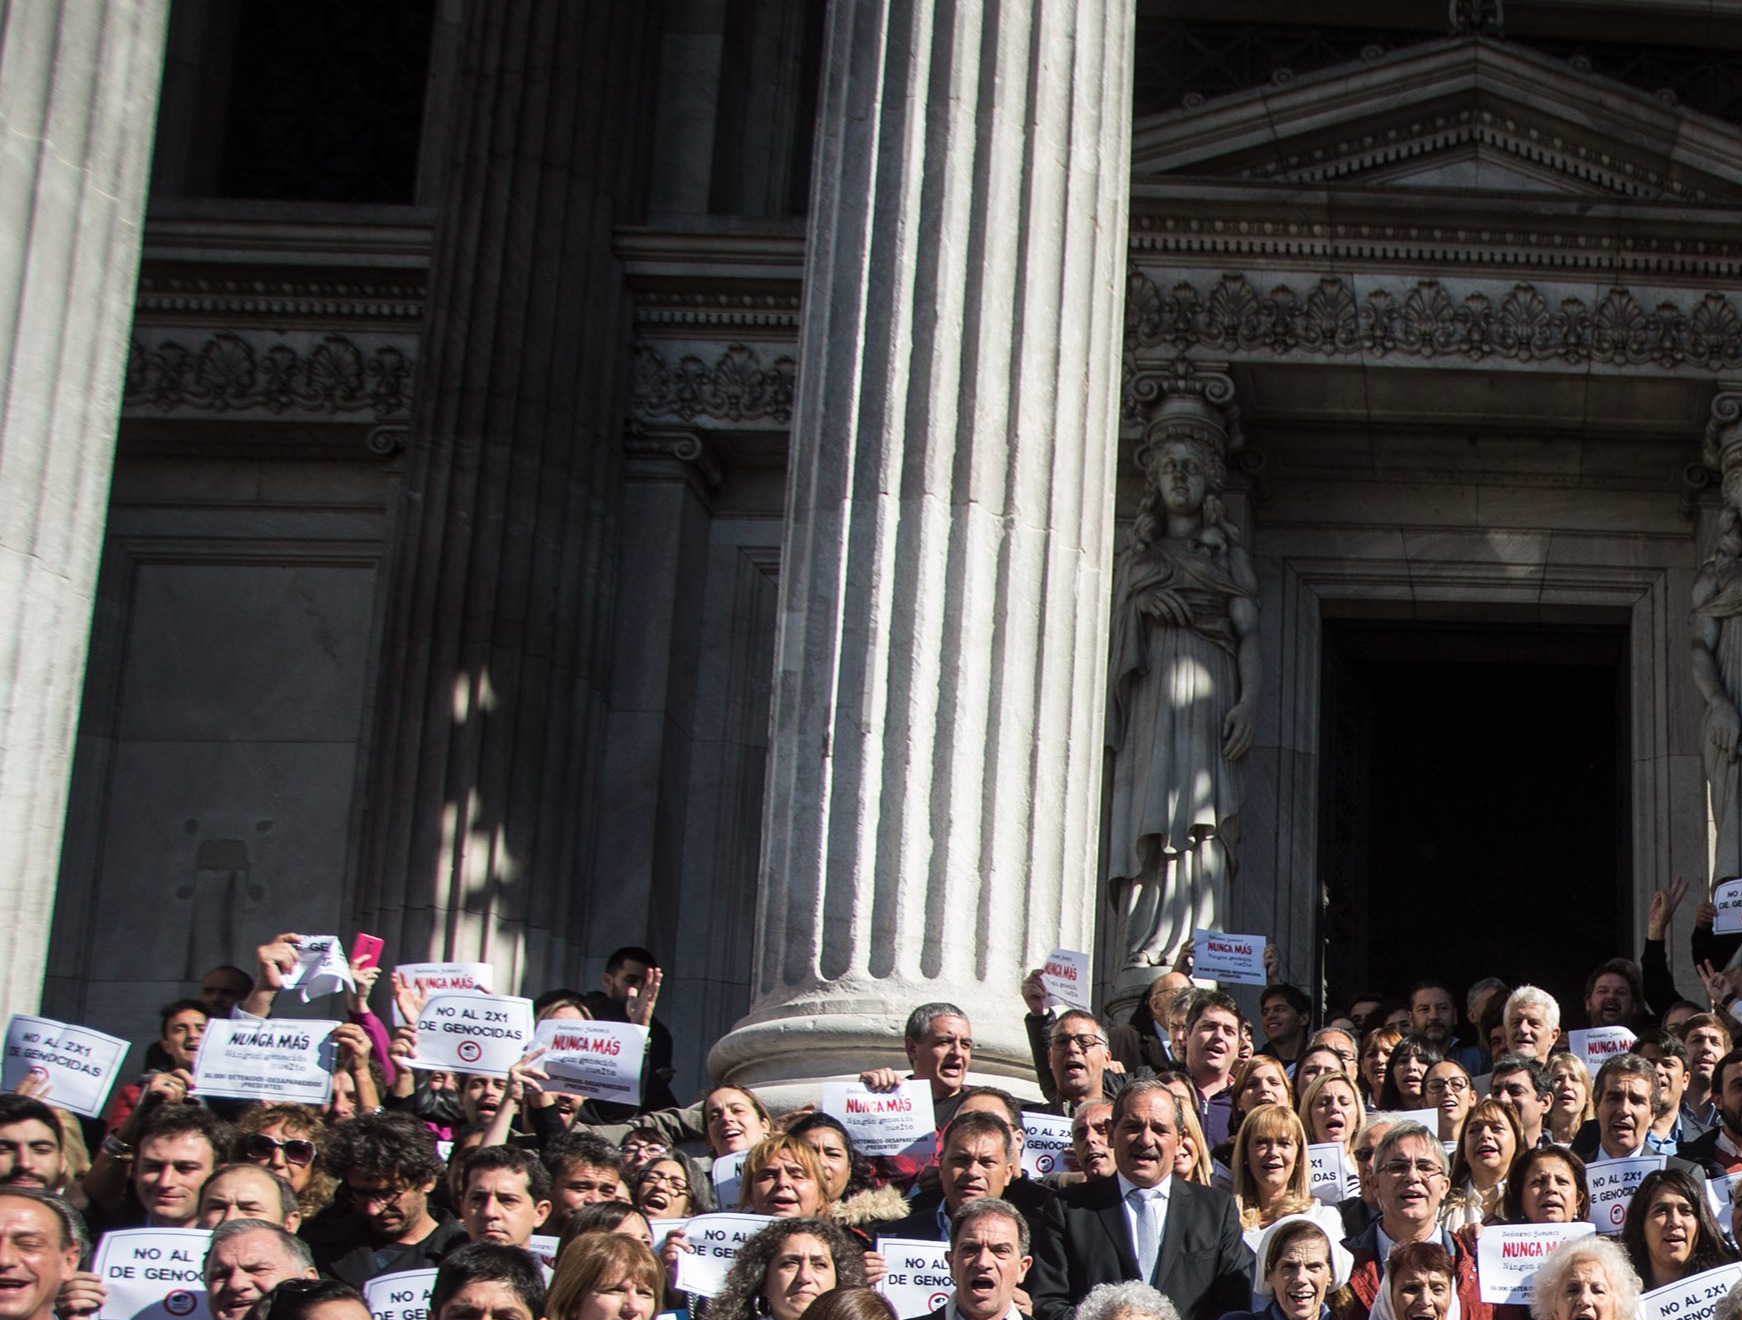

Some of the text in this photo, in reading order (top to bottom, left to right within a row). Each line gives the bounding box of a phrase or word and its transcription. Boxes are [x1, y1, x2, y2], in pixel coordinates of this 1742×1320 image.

[1727, 890, 1739, 898] NO
[1719, 902, 1730, 910] DE
[1207, 942, 1235, 953] NUNCA
[450, 974, 474, 990] MÁS
[436, 1006, 509, 1023] NO AL 2X1
[419, 1021, 523, 1041] DE GENOCIDAS
[22, 1032, 93, 1057] NO AL 2X1
[228, 1030, 311, 1051] NUNCA MÁS
[551, 1034, 621, 1056] NUNCA MÁS
[1587, 1040, 1619, 1055] NUNCA
[25, 1047, 102, 1078] GENOCIDAS
[846, 1093, 913, 1113] NUNCA MÁS
[1041, 1127, 1056, 1137] AL
[1059, 1130, 1074, 1138] 2X
[1592, 1170, 1643, 1188] NO AL 2X1
[704, 1229, 726, 1242] NO
[134, 1248, 194, 1262] NO AL
[1502, 1242, 1543, 1258] NUNCA
[905, 1257, 948, 1270] NO AL
[110, 1266, 134, 1279] DE
[888, 1274, 907, 1286] DE
[390, 1290, 414, 1303] NO
[1659, 1282, 1728, 1317] NO AL 2X1
